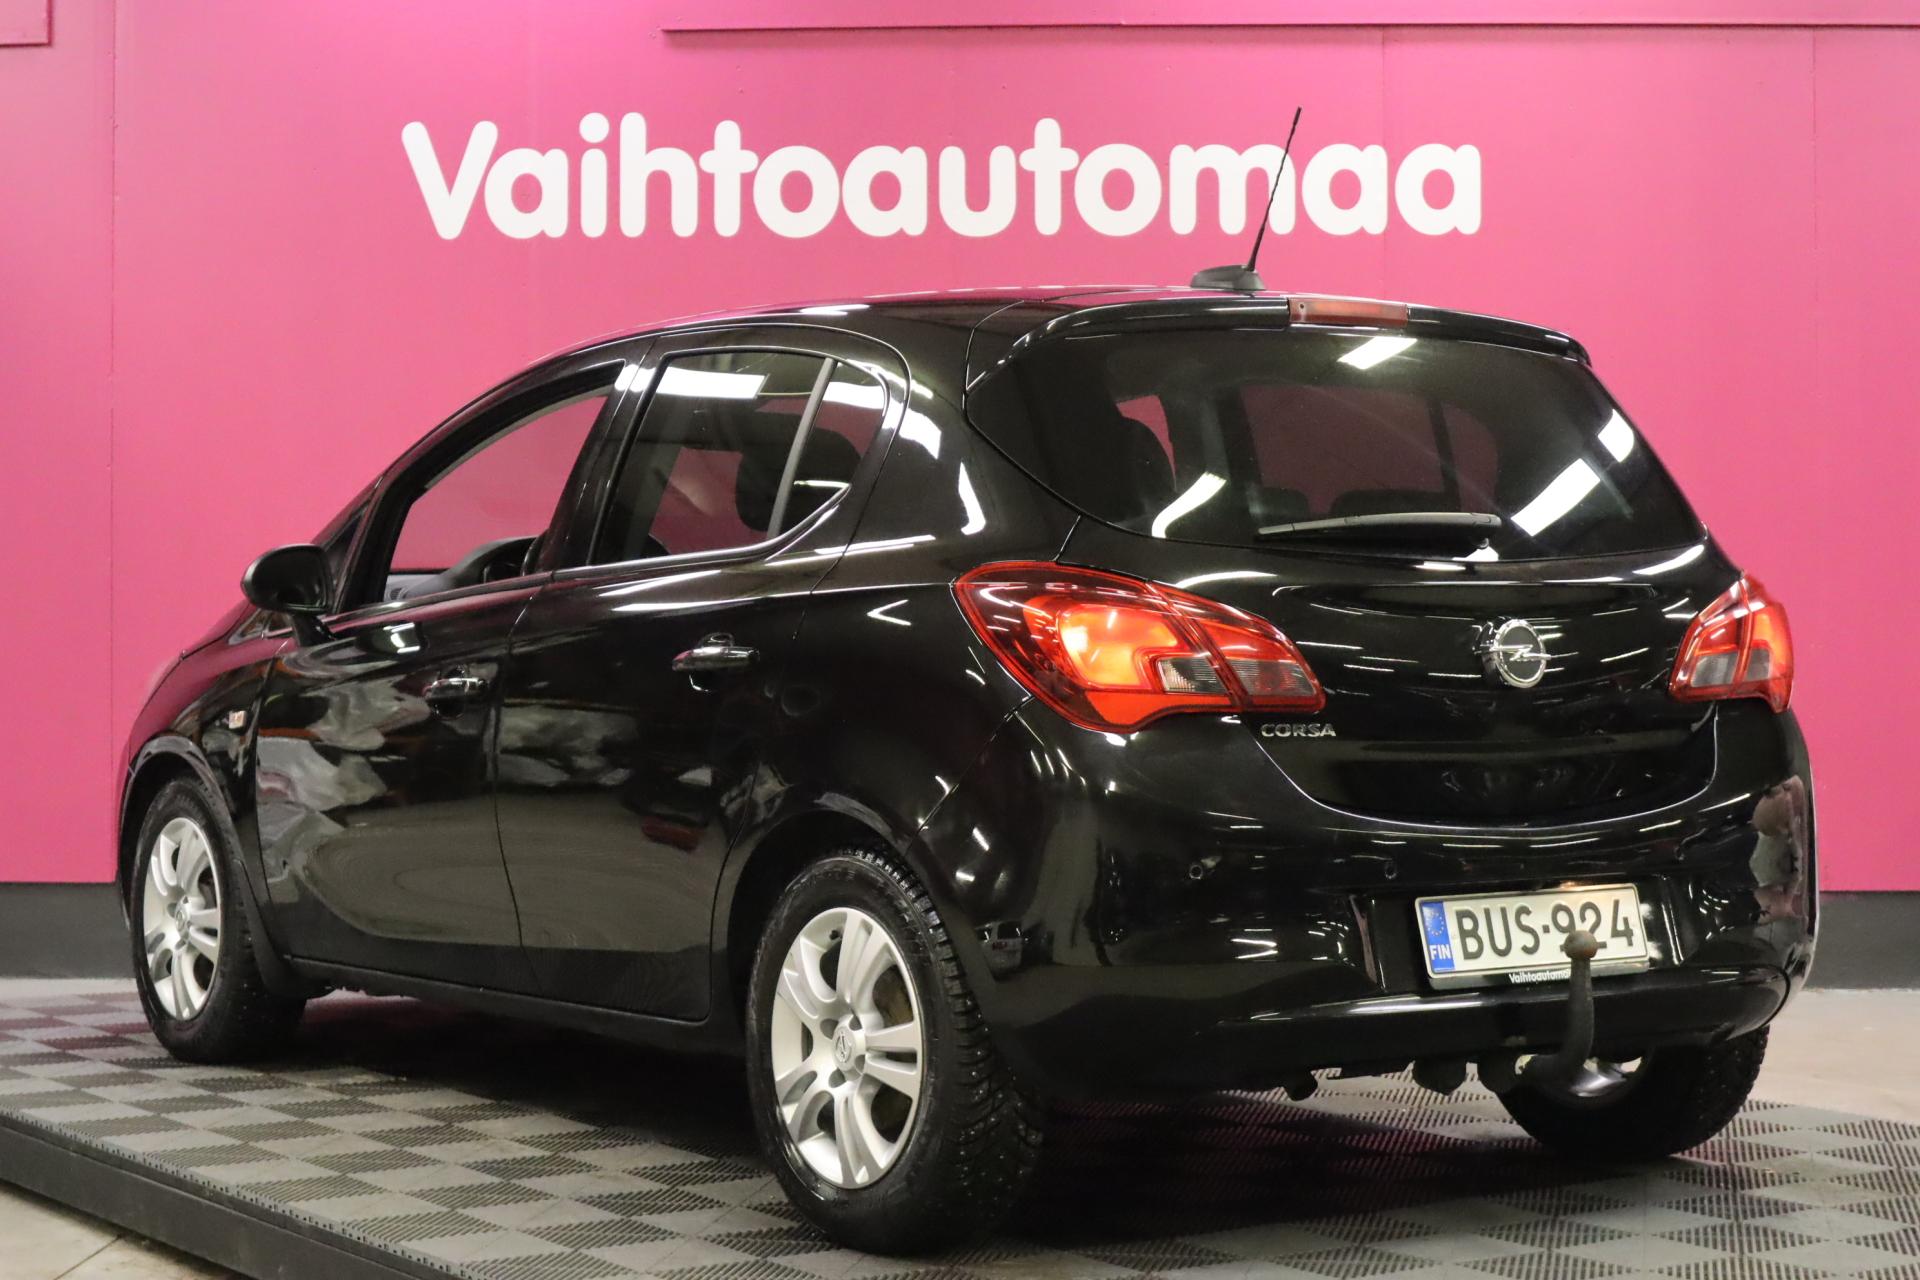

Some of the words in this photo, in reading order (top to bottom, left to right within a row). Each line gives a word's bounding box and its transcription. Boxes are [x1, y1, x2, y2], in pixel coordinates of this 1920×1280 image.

[401, 112, 1482, 239] Vaihtoautomaa
[1260, 723, 1337, 738] CORSA
[1455, 899, 1634, 960] BUS-924
[1429, 943, 1451, 961] FIN
[1508, 968, 1572, 984] Vaihtoautoma
